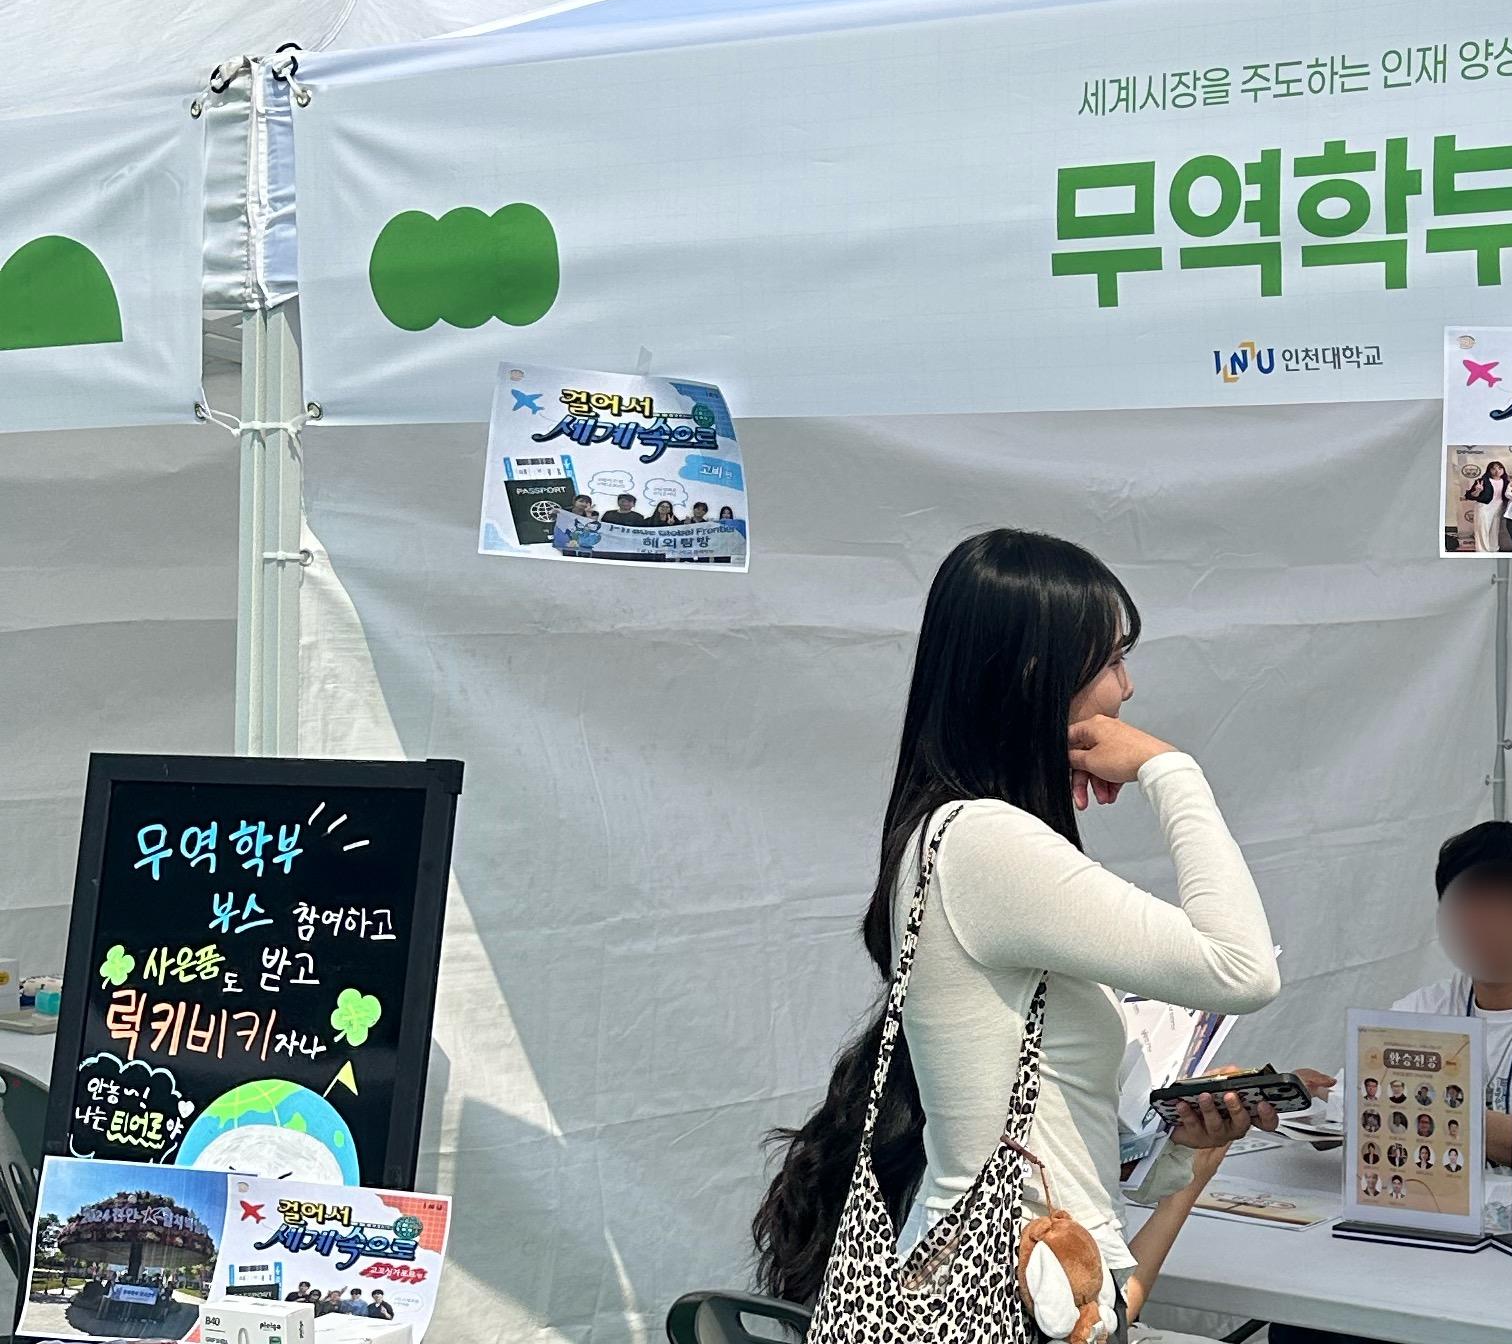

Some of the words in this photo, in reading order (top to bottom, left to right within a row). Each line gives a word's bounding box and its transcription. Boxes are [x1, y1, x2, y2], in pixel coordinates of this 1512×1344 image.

[1078, 65, 1231, 117] 세계시장을
[1240, 53, 1372, 105] 주도하는
[1380, 44, 1447, 88] 인재
[1212, 343, 1275, 380] INU
[1280, 343, 1384, 372] 인천대학교
[559, 389, 653, 417] 걸어서
[531, 414, 719, 463] 세계속으로
[515, 486, 567, 495] PASSPORT
[134, 820, 304, 881] 무역학부
[208, 892, 274, 934] 부스
[292, 901, 396, 942] 참여하고
[142, 944, 244, 993] 사은품도
[259, 946, 320, 992] 받고
[105, 989, 327, 1062] 럭키비키자나
[75, 1105, 108, 1132] 나는
[277, 1199, 352, 1226] 걸어서
[254, 1223, 418, 1271] 세계속으로
[205, 1316, 221, 1326] B40
